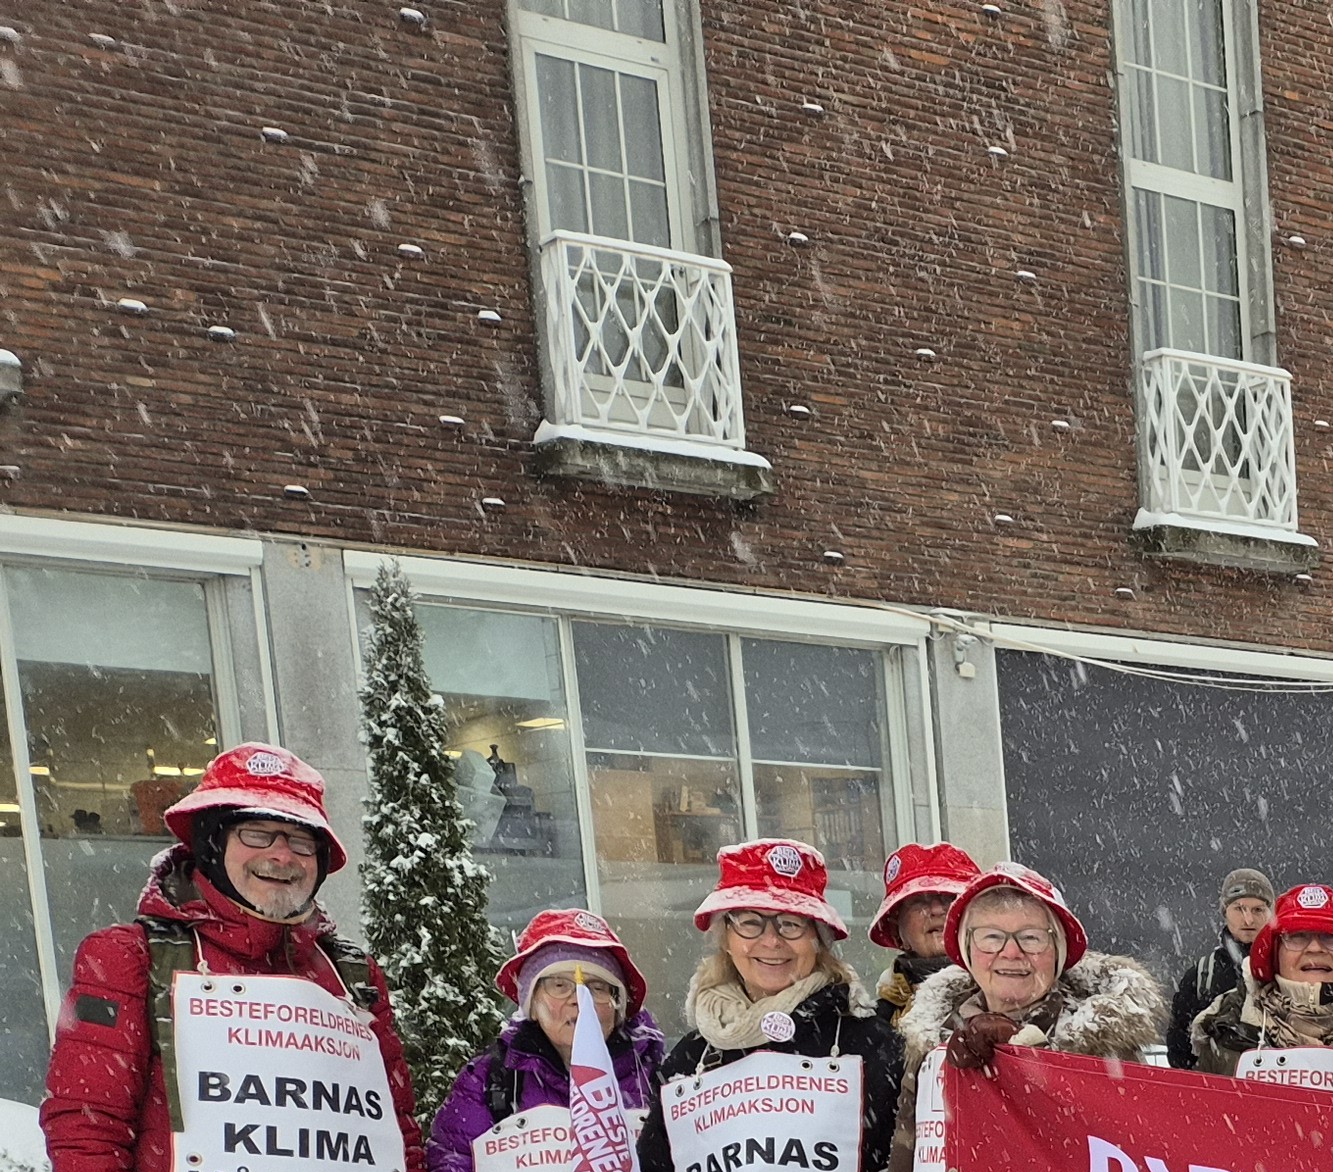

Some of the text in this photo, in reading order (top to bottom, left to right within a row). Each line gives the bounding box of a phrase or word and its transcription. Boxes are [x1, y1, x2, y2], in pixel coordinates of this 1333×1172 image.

[189, 997, 374, 1042] BESTEFORELDRENES
[227, 1027, 361, 1061] KLIMAAKSJON
[198, 1071, 384, 1121] BARNAS
[670, 1074, 850, 1121] BESTEFORELDRENES
[693, 1097, 815, 1135] KLIMAAKSJON
[223, 1122, 377, 1166] KLIMA
